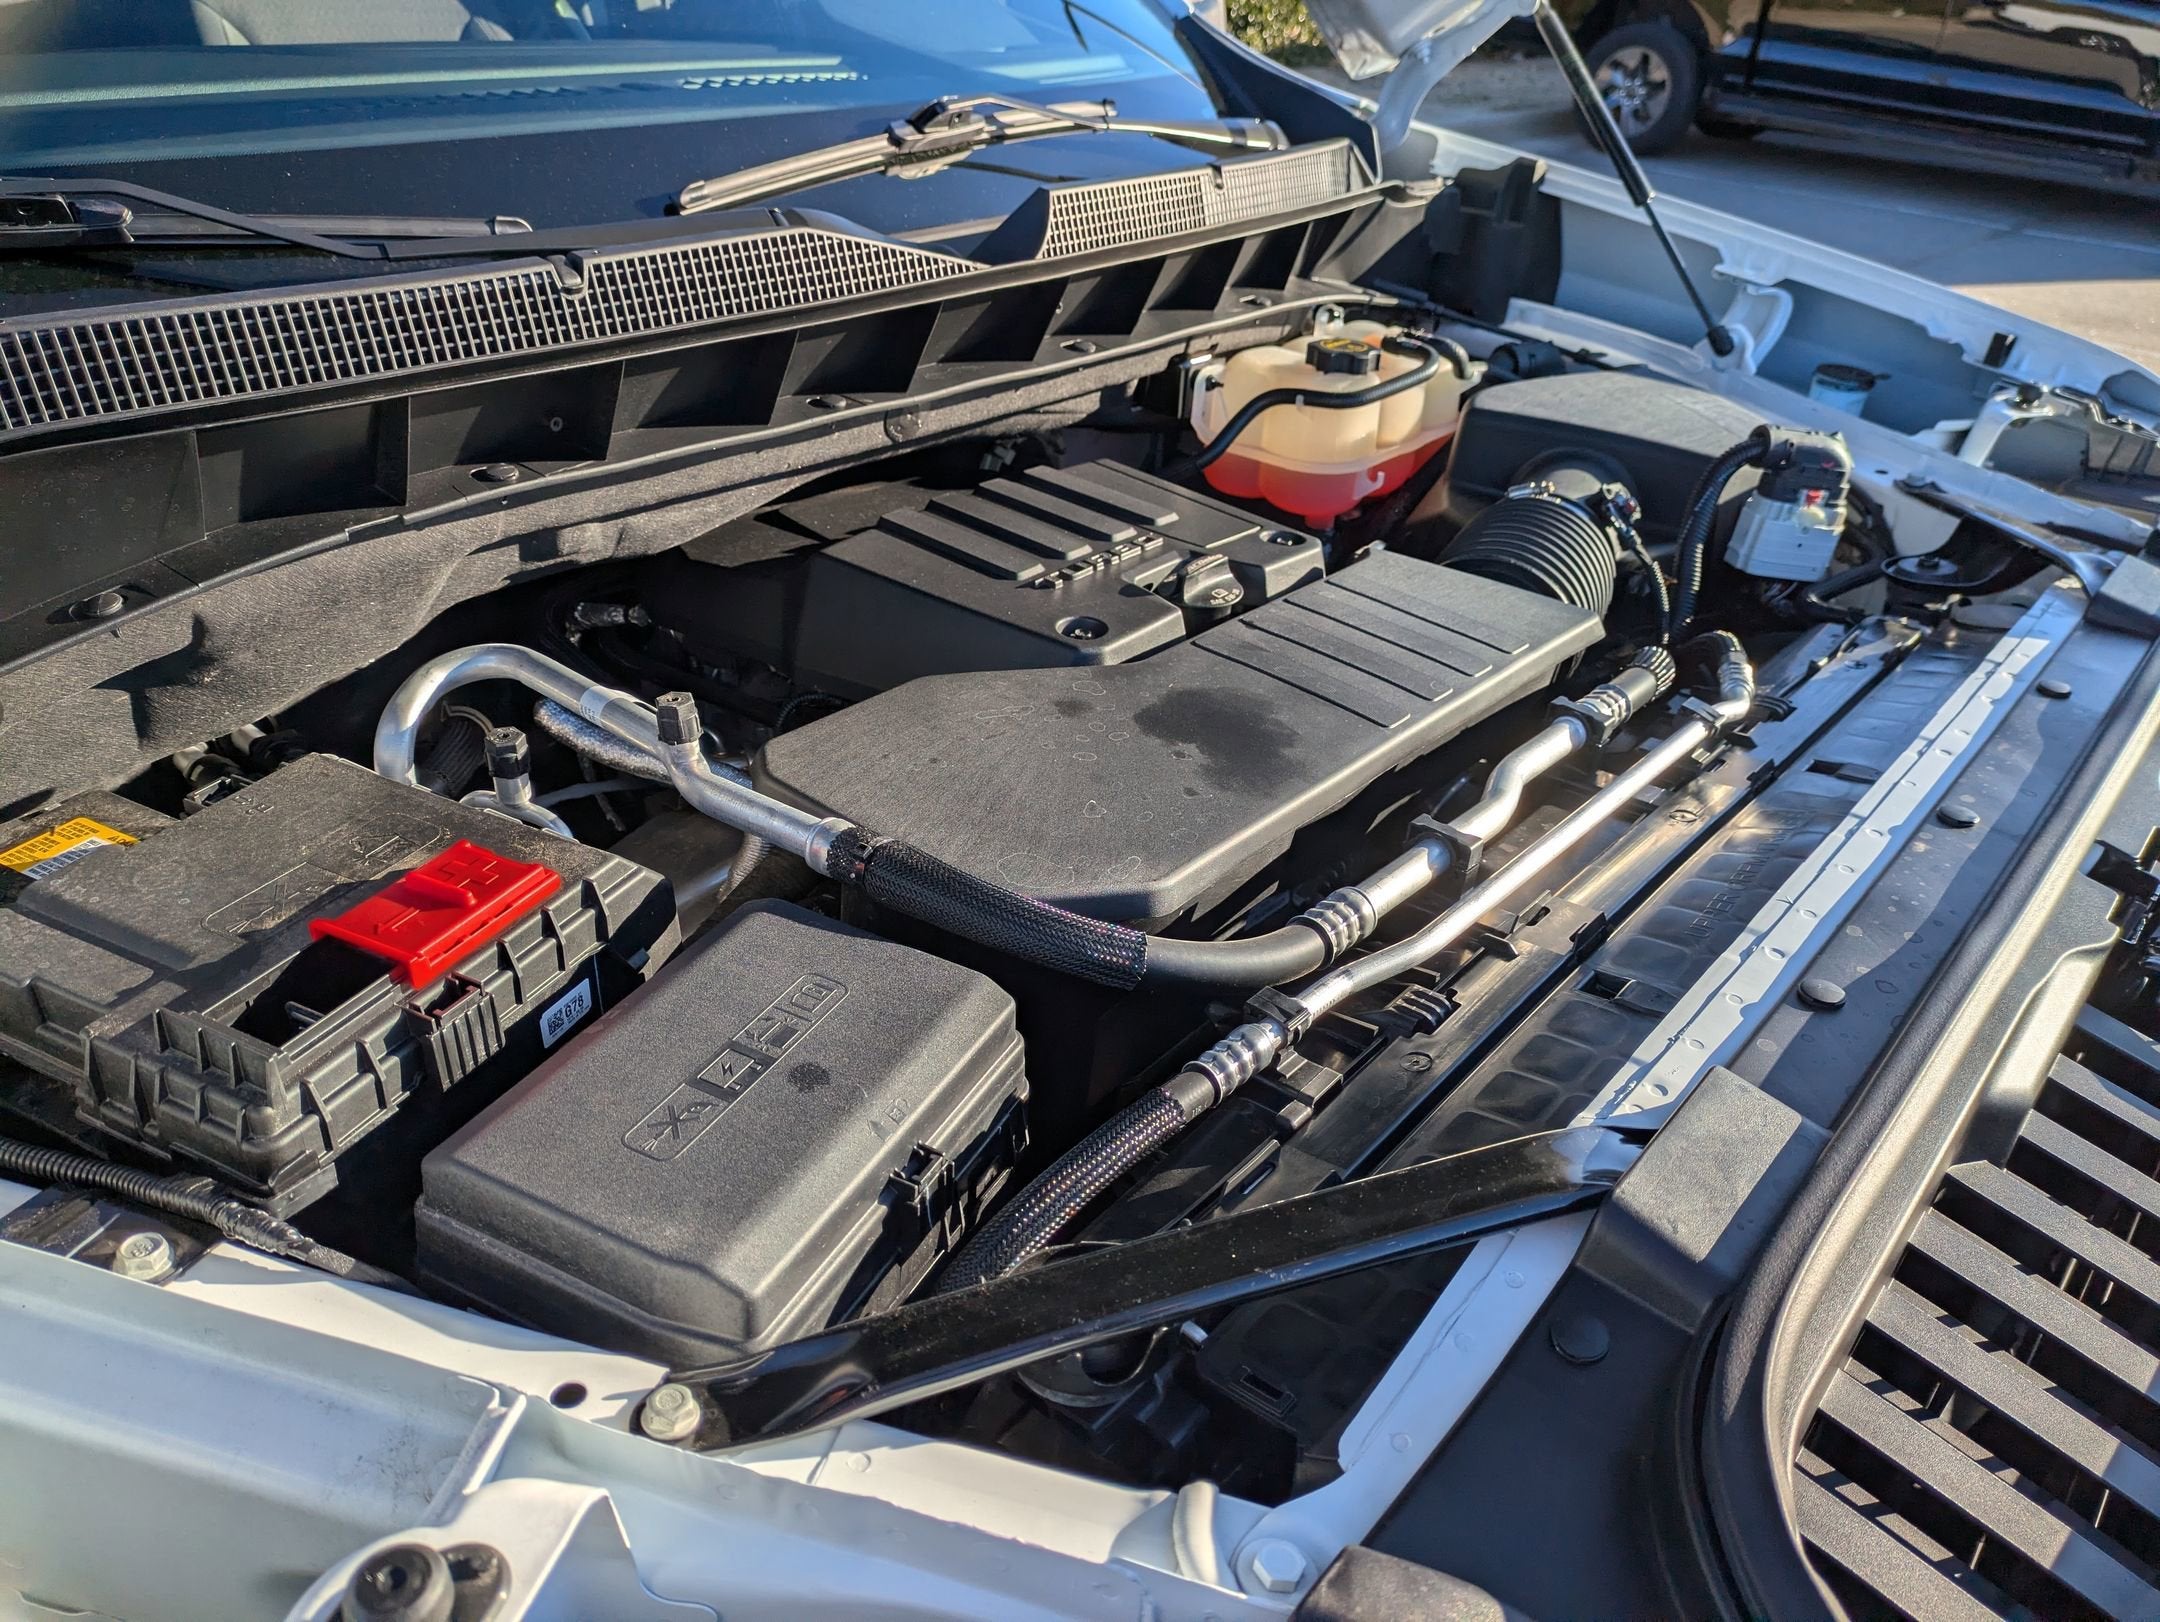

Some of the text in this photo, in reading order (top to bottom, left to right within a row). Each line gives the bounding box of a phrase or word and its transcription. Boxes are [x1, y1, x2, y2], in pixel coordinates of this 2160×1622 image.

[1034, 536, 1164, 590] TURBO
[1684, 892, 1741, 939] UPPER
[563, 995, 584, 1018] G78
